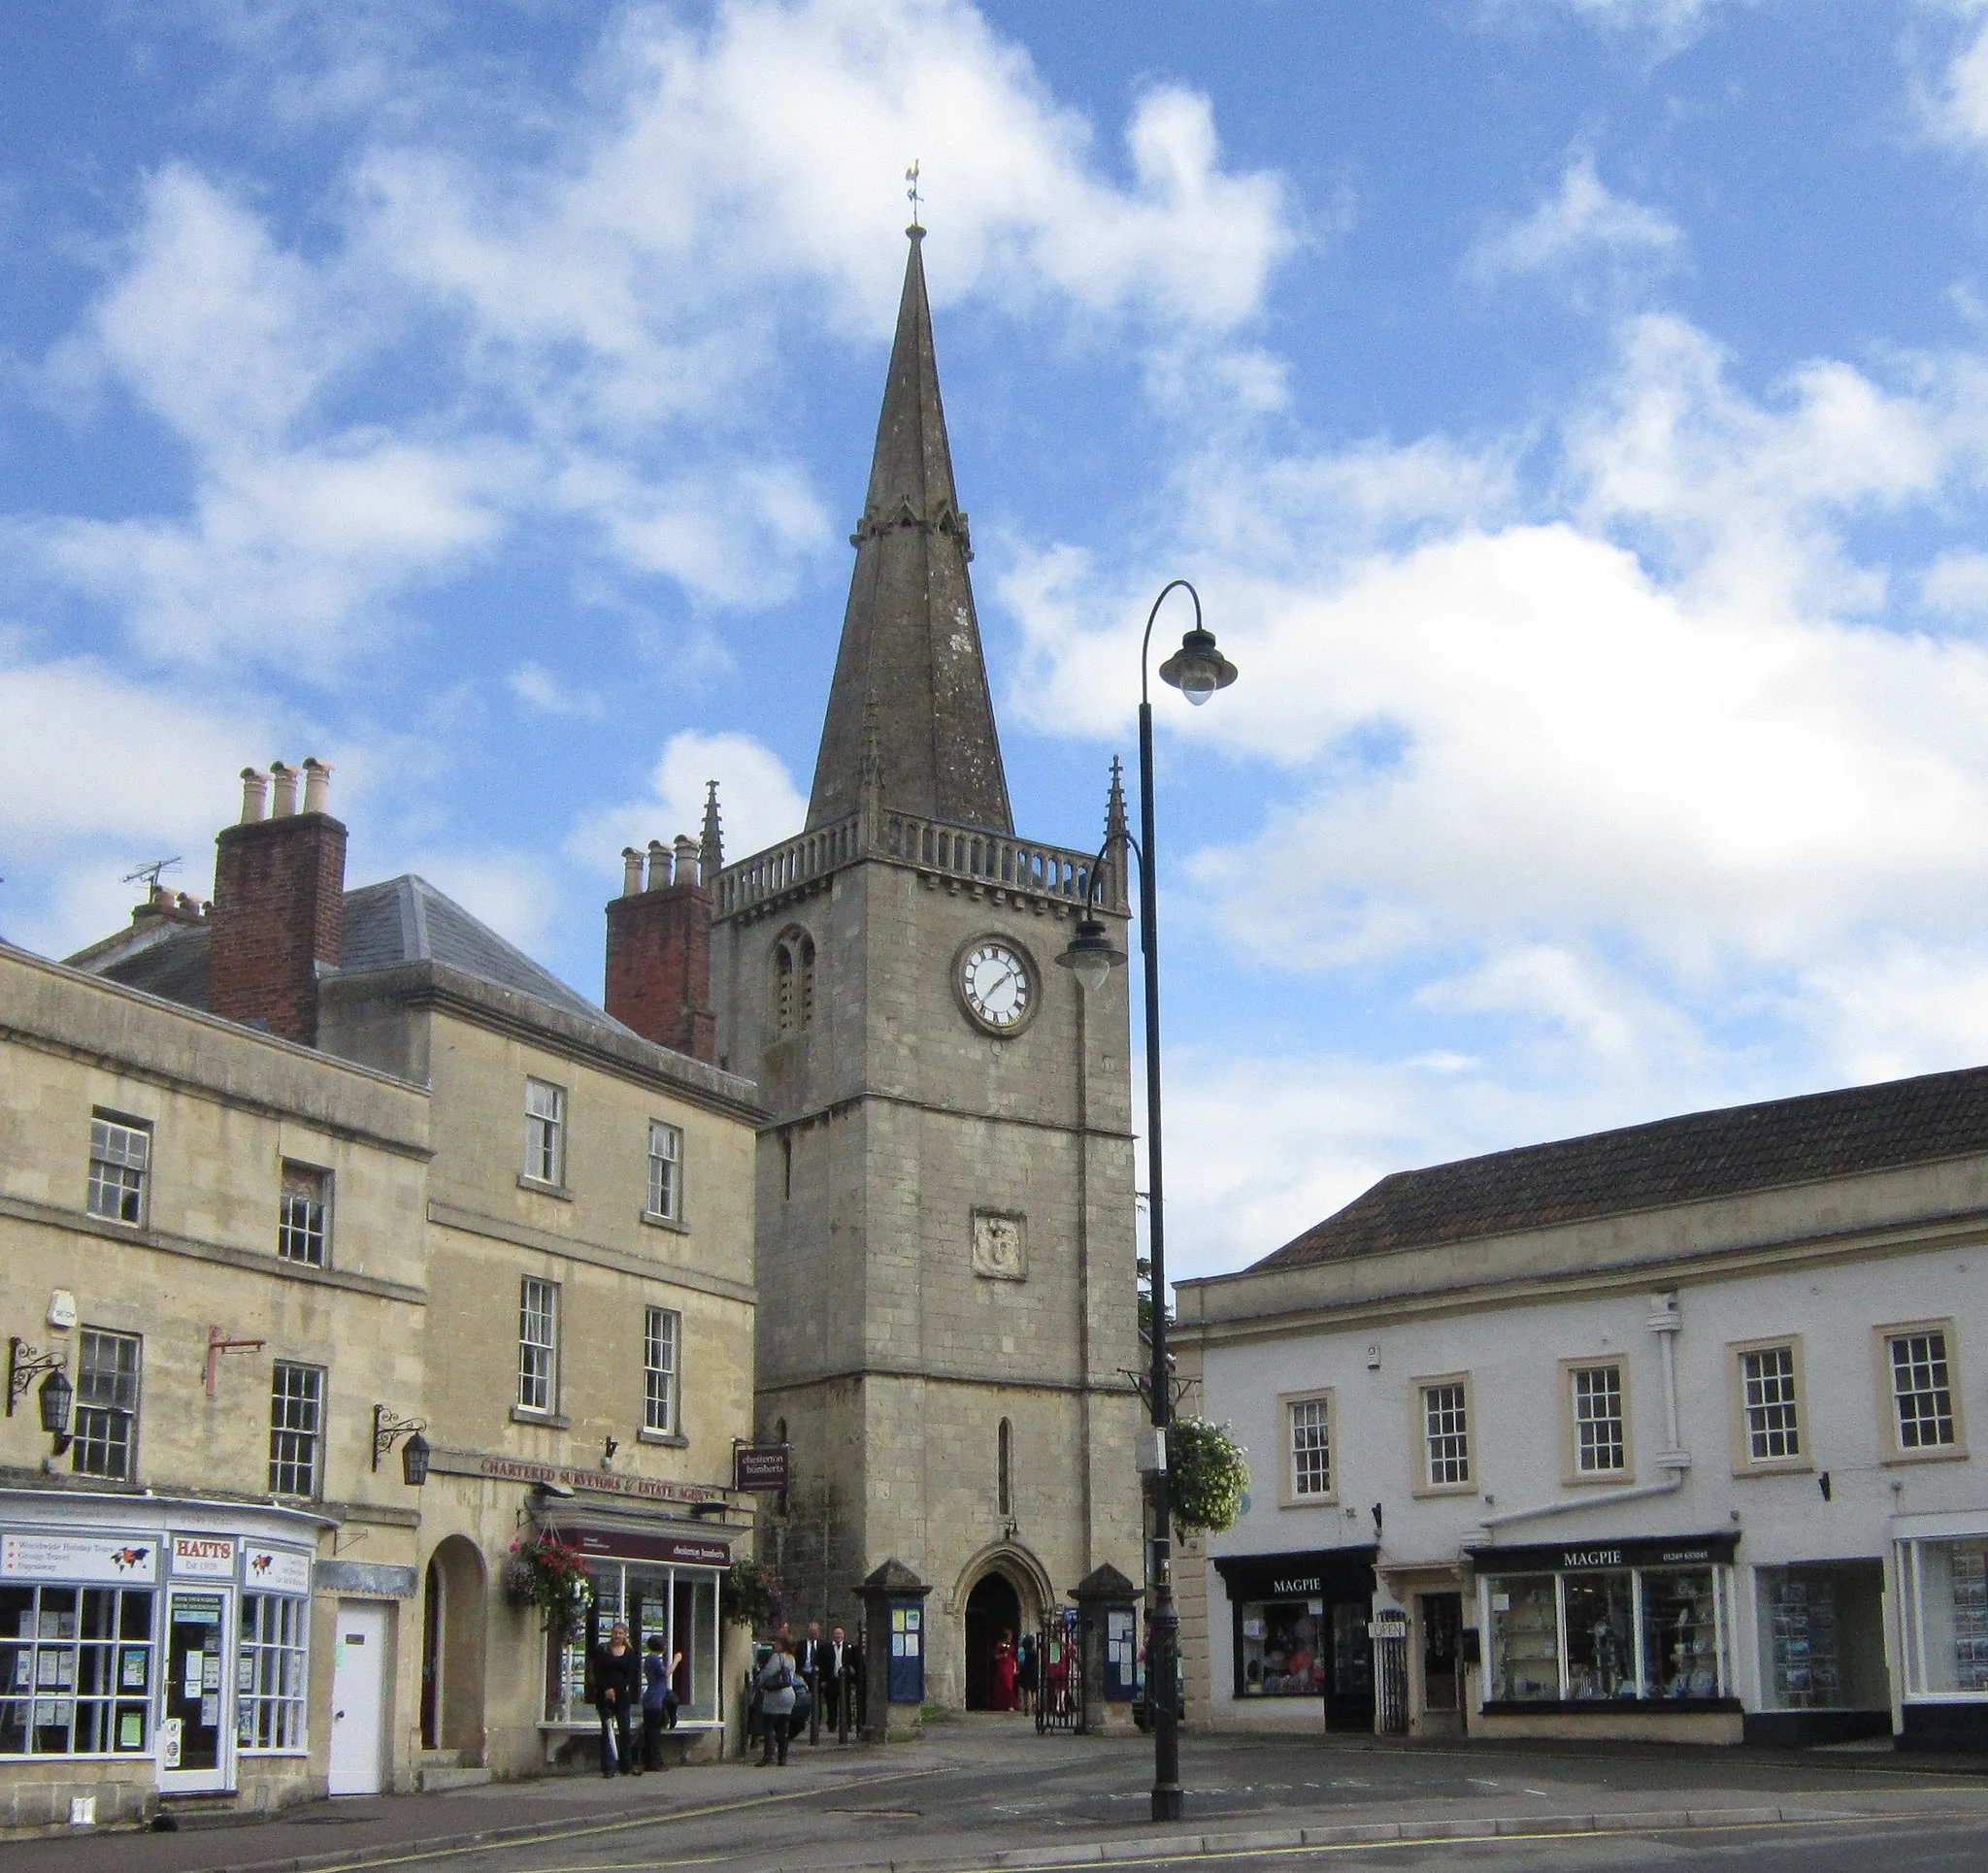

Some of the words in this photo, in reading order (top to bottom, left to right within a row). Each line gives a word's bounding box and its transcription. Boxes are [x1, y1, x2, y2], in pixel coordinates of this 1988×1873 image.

[742, 1455, 783, 1464] chesterton
[480, 1459, 555, 1482] CHARTERED
[559, 1469, 620, 1492] SURVEYORS
[638, 1480, 675, 1497] ESTATE
[679, 1486, 715, 1501] AGENTS
[177, 1539, 232, 1560] HATTS
[1564, 1551, 1622, 1566] MAGPIE
[1274, 1578, 1321, 1593] MAGPIE
[1374, 1623, 1405, 1637] OPEN
